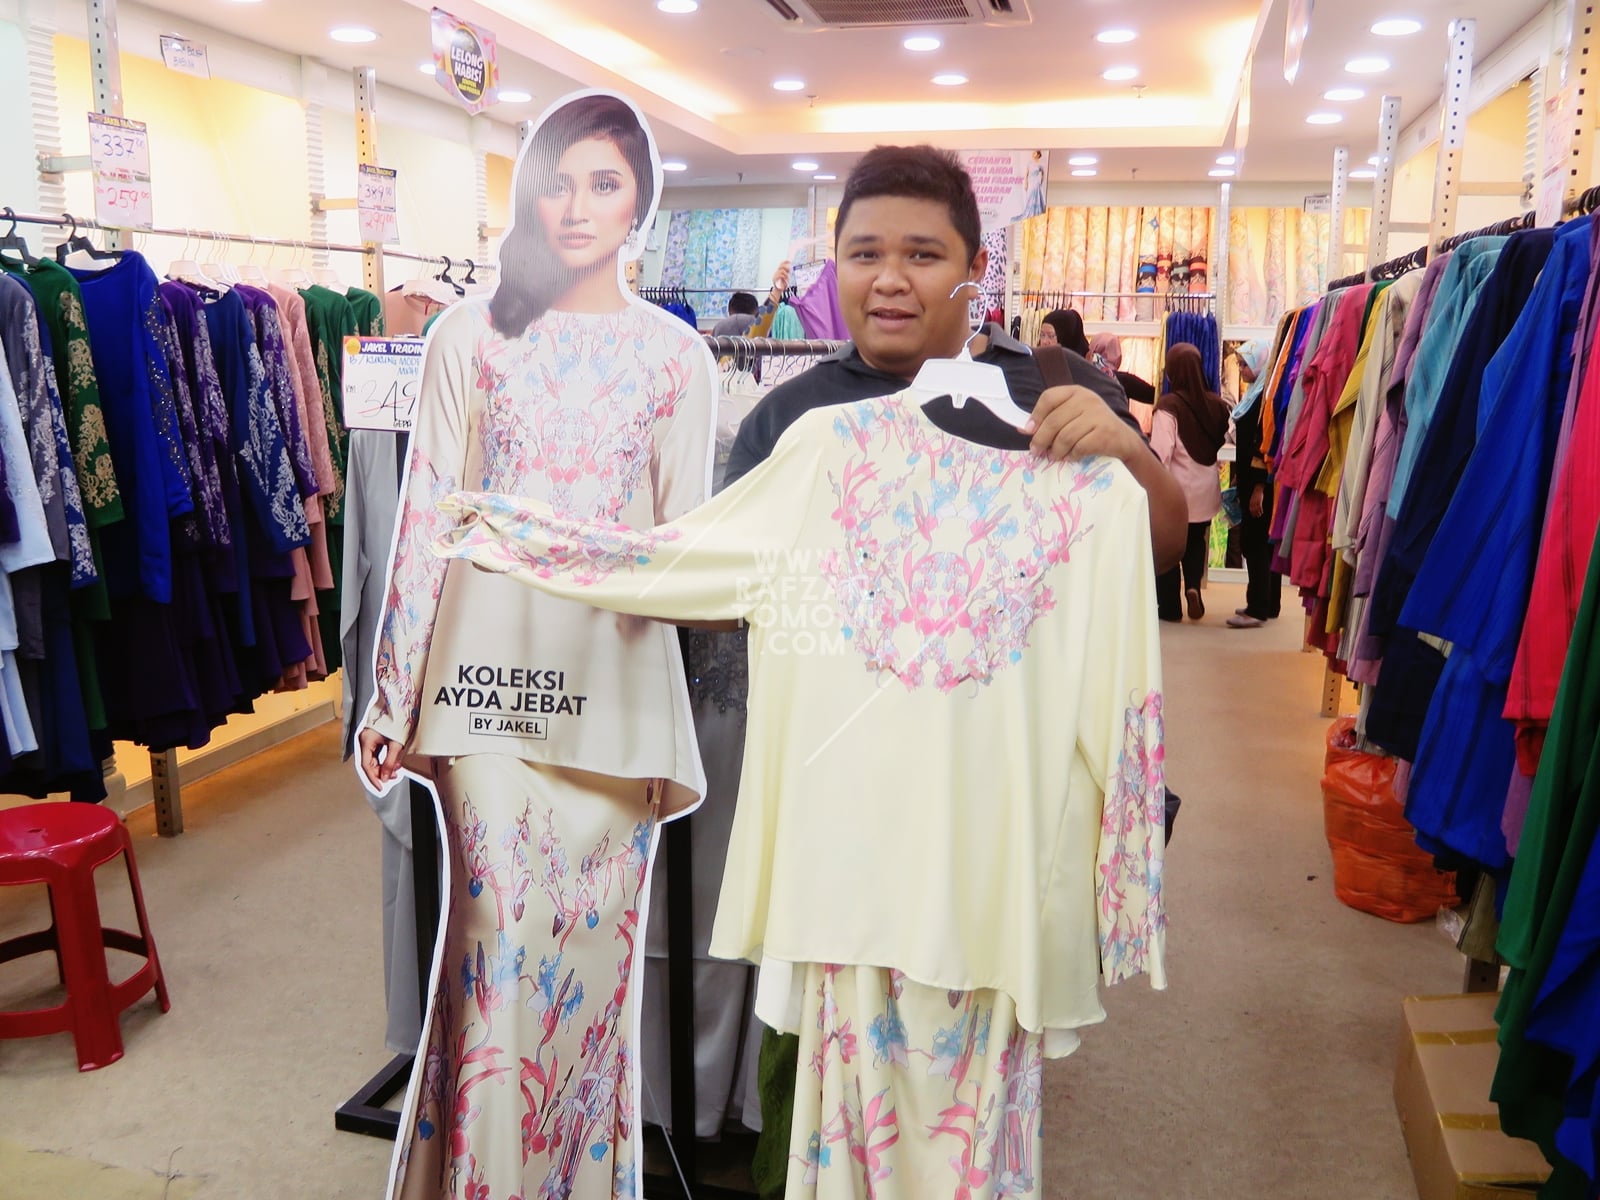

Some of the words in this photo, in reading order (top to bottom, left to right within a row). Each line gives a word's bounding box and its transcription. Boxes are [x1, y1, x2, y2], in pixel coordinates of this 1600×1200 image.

[452, 46, 483, 69] LELONG
[454, 62, 482, 84] HABIS!
[968, 156, 1012, 165] CERIANYA
[989, 166, 1013, 175] ANDA
[992, 176, 1024, 185] FABRIK
[107, 187, 138, 210] 259
[362, 342, 387, 353] JAKEL
[458, 665, 564, 691] KOLEKSI
[434, 686, 501, 710] AYDA
[510, 692, 587, 716] JEBAT
[474, 718, 493, 730] BY
[497, 720, 541, 734] JAKEL
